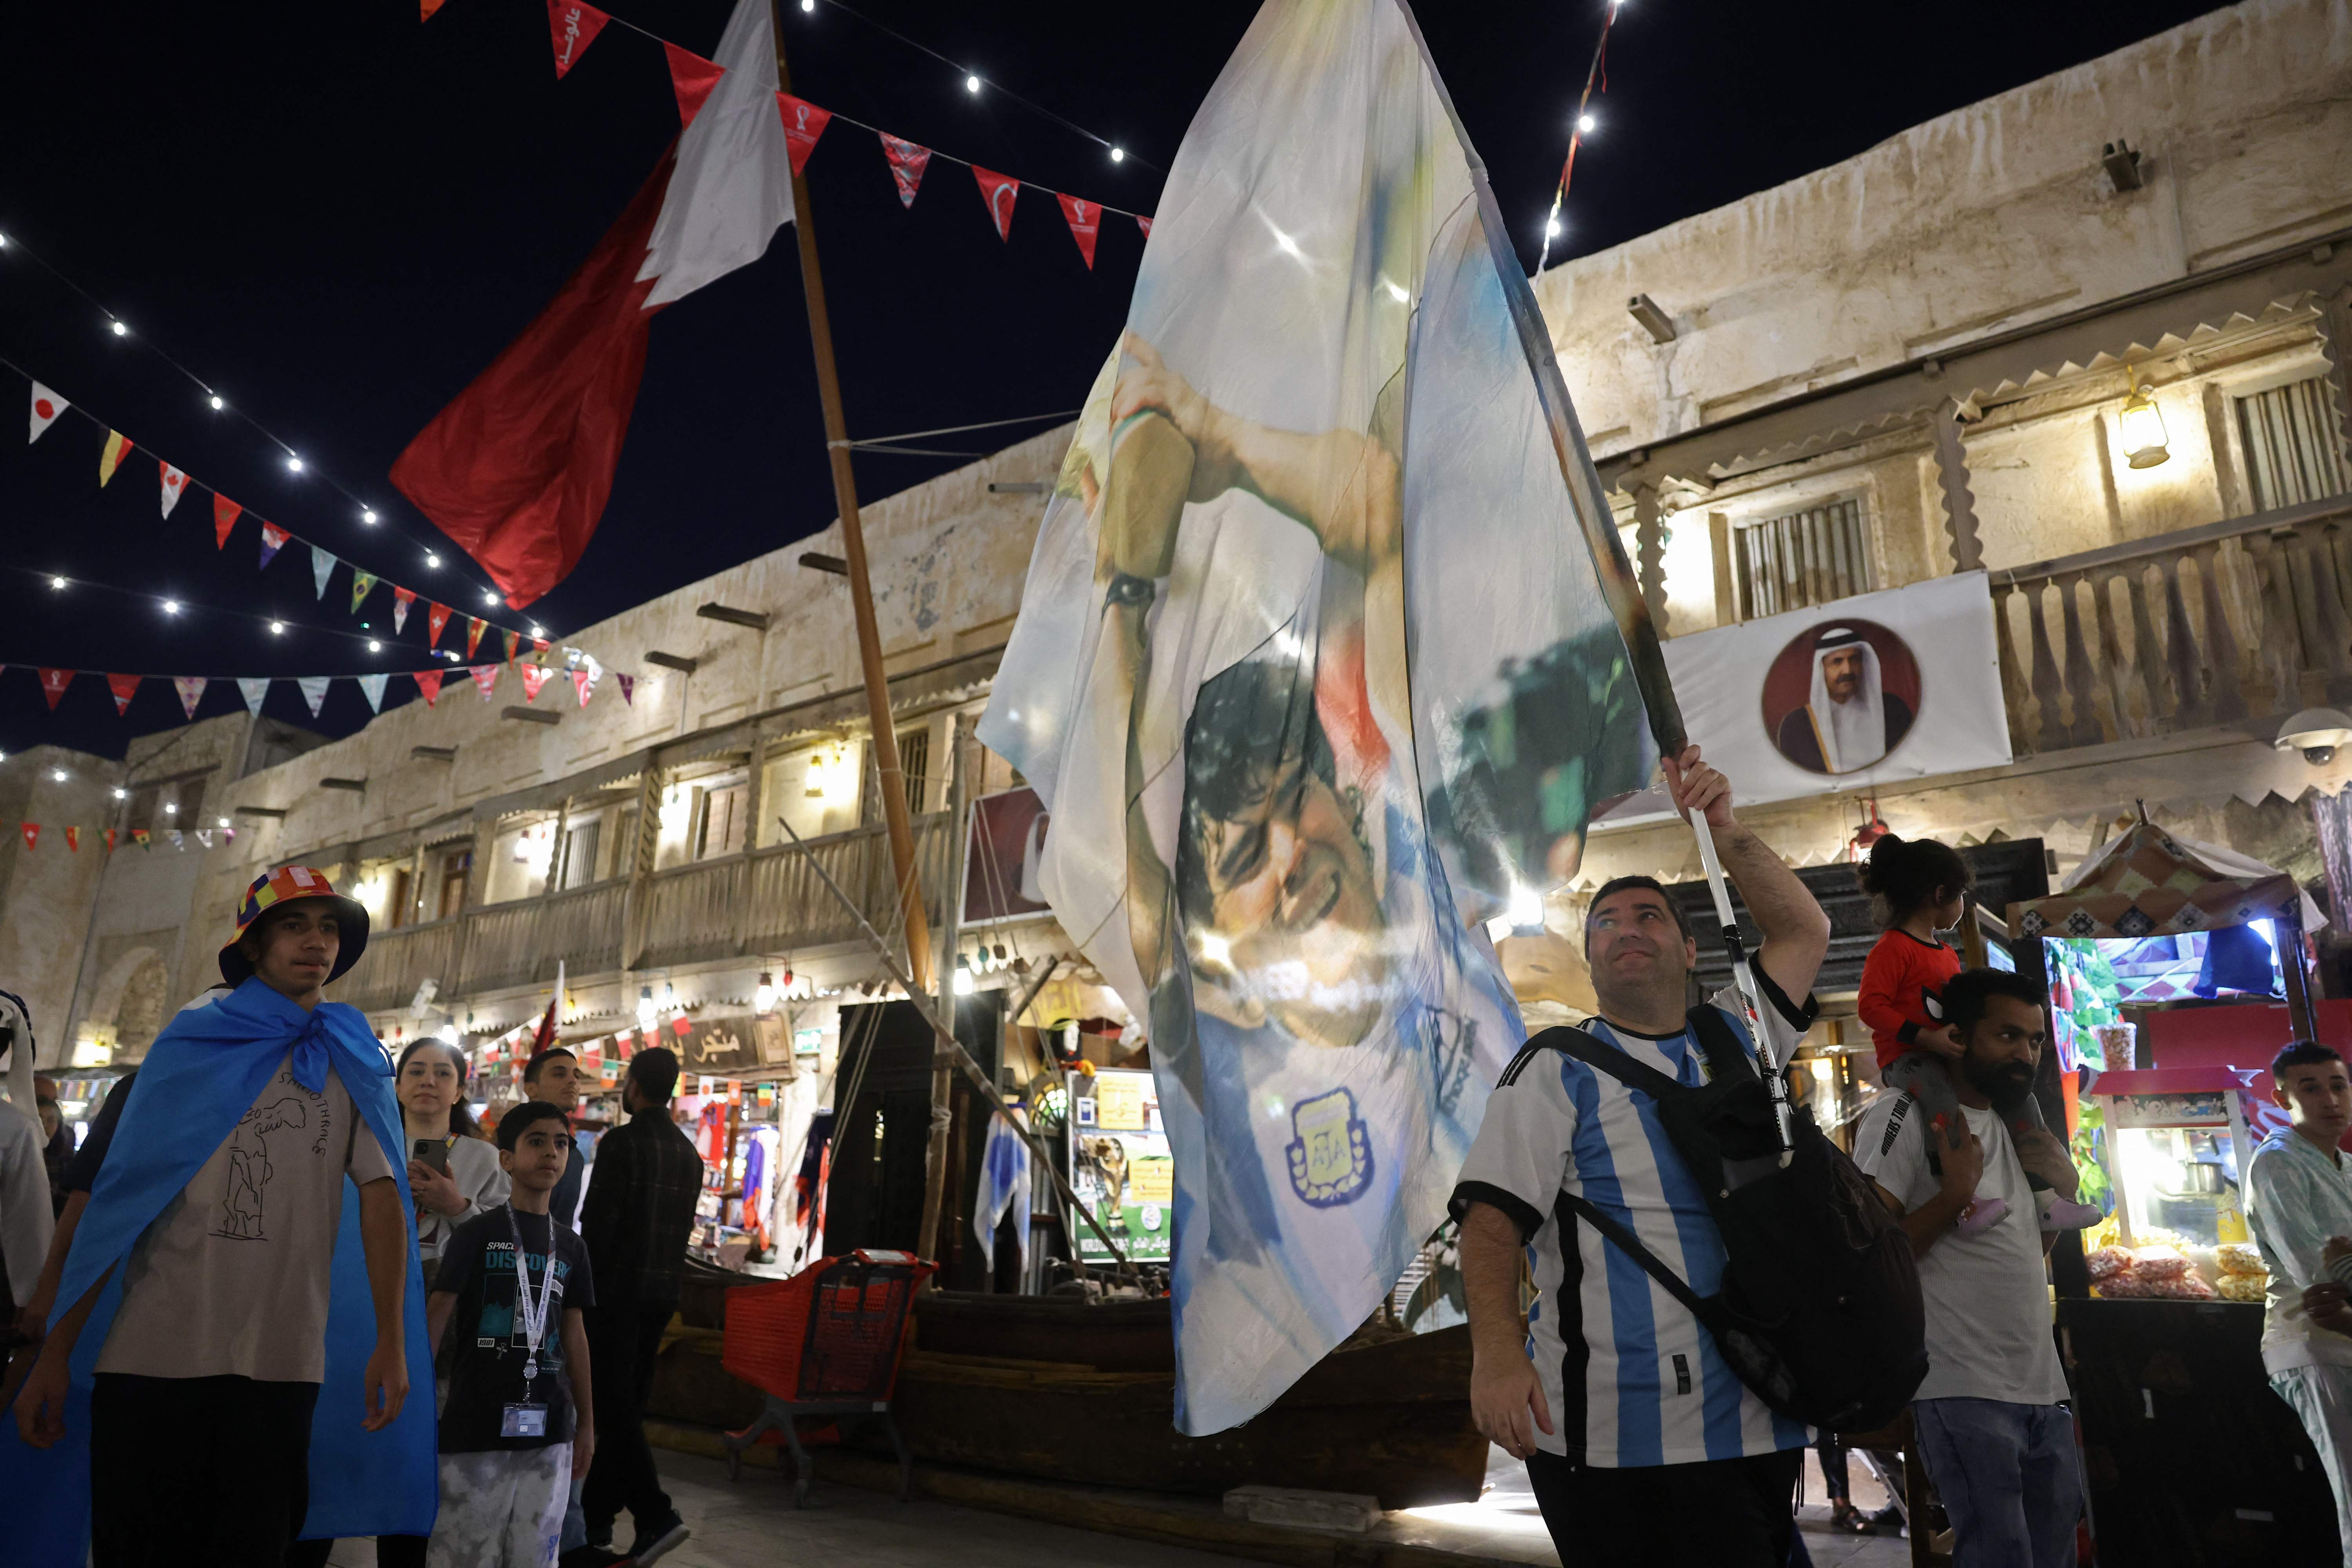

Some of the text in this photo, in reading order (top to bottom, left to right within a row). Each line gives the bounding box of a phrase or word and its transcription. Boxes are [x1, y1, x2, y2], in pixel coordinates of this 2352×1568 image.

[693, 1028, 740, 1063] متجر
[1881, 1118, 1901, 1157] WINNERS
[1891, 1099, 1910, 1122] TRAIN
